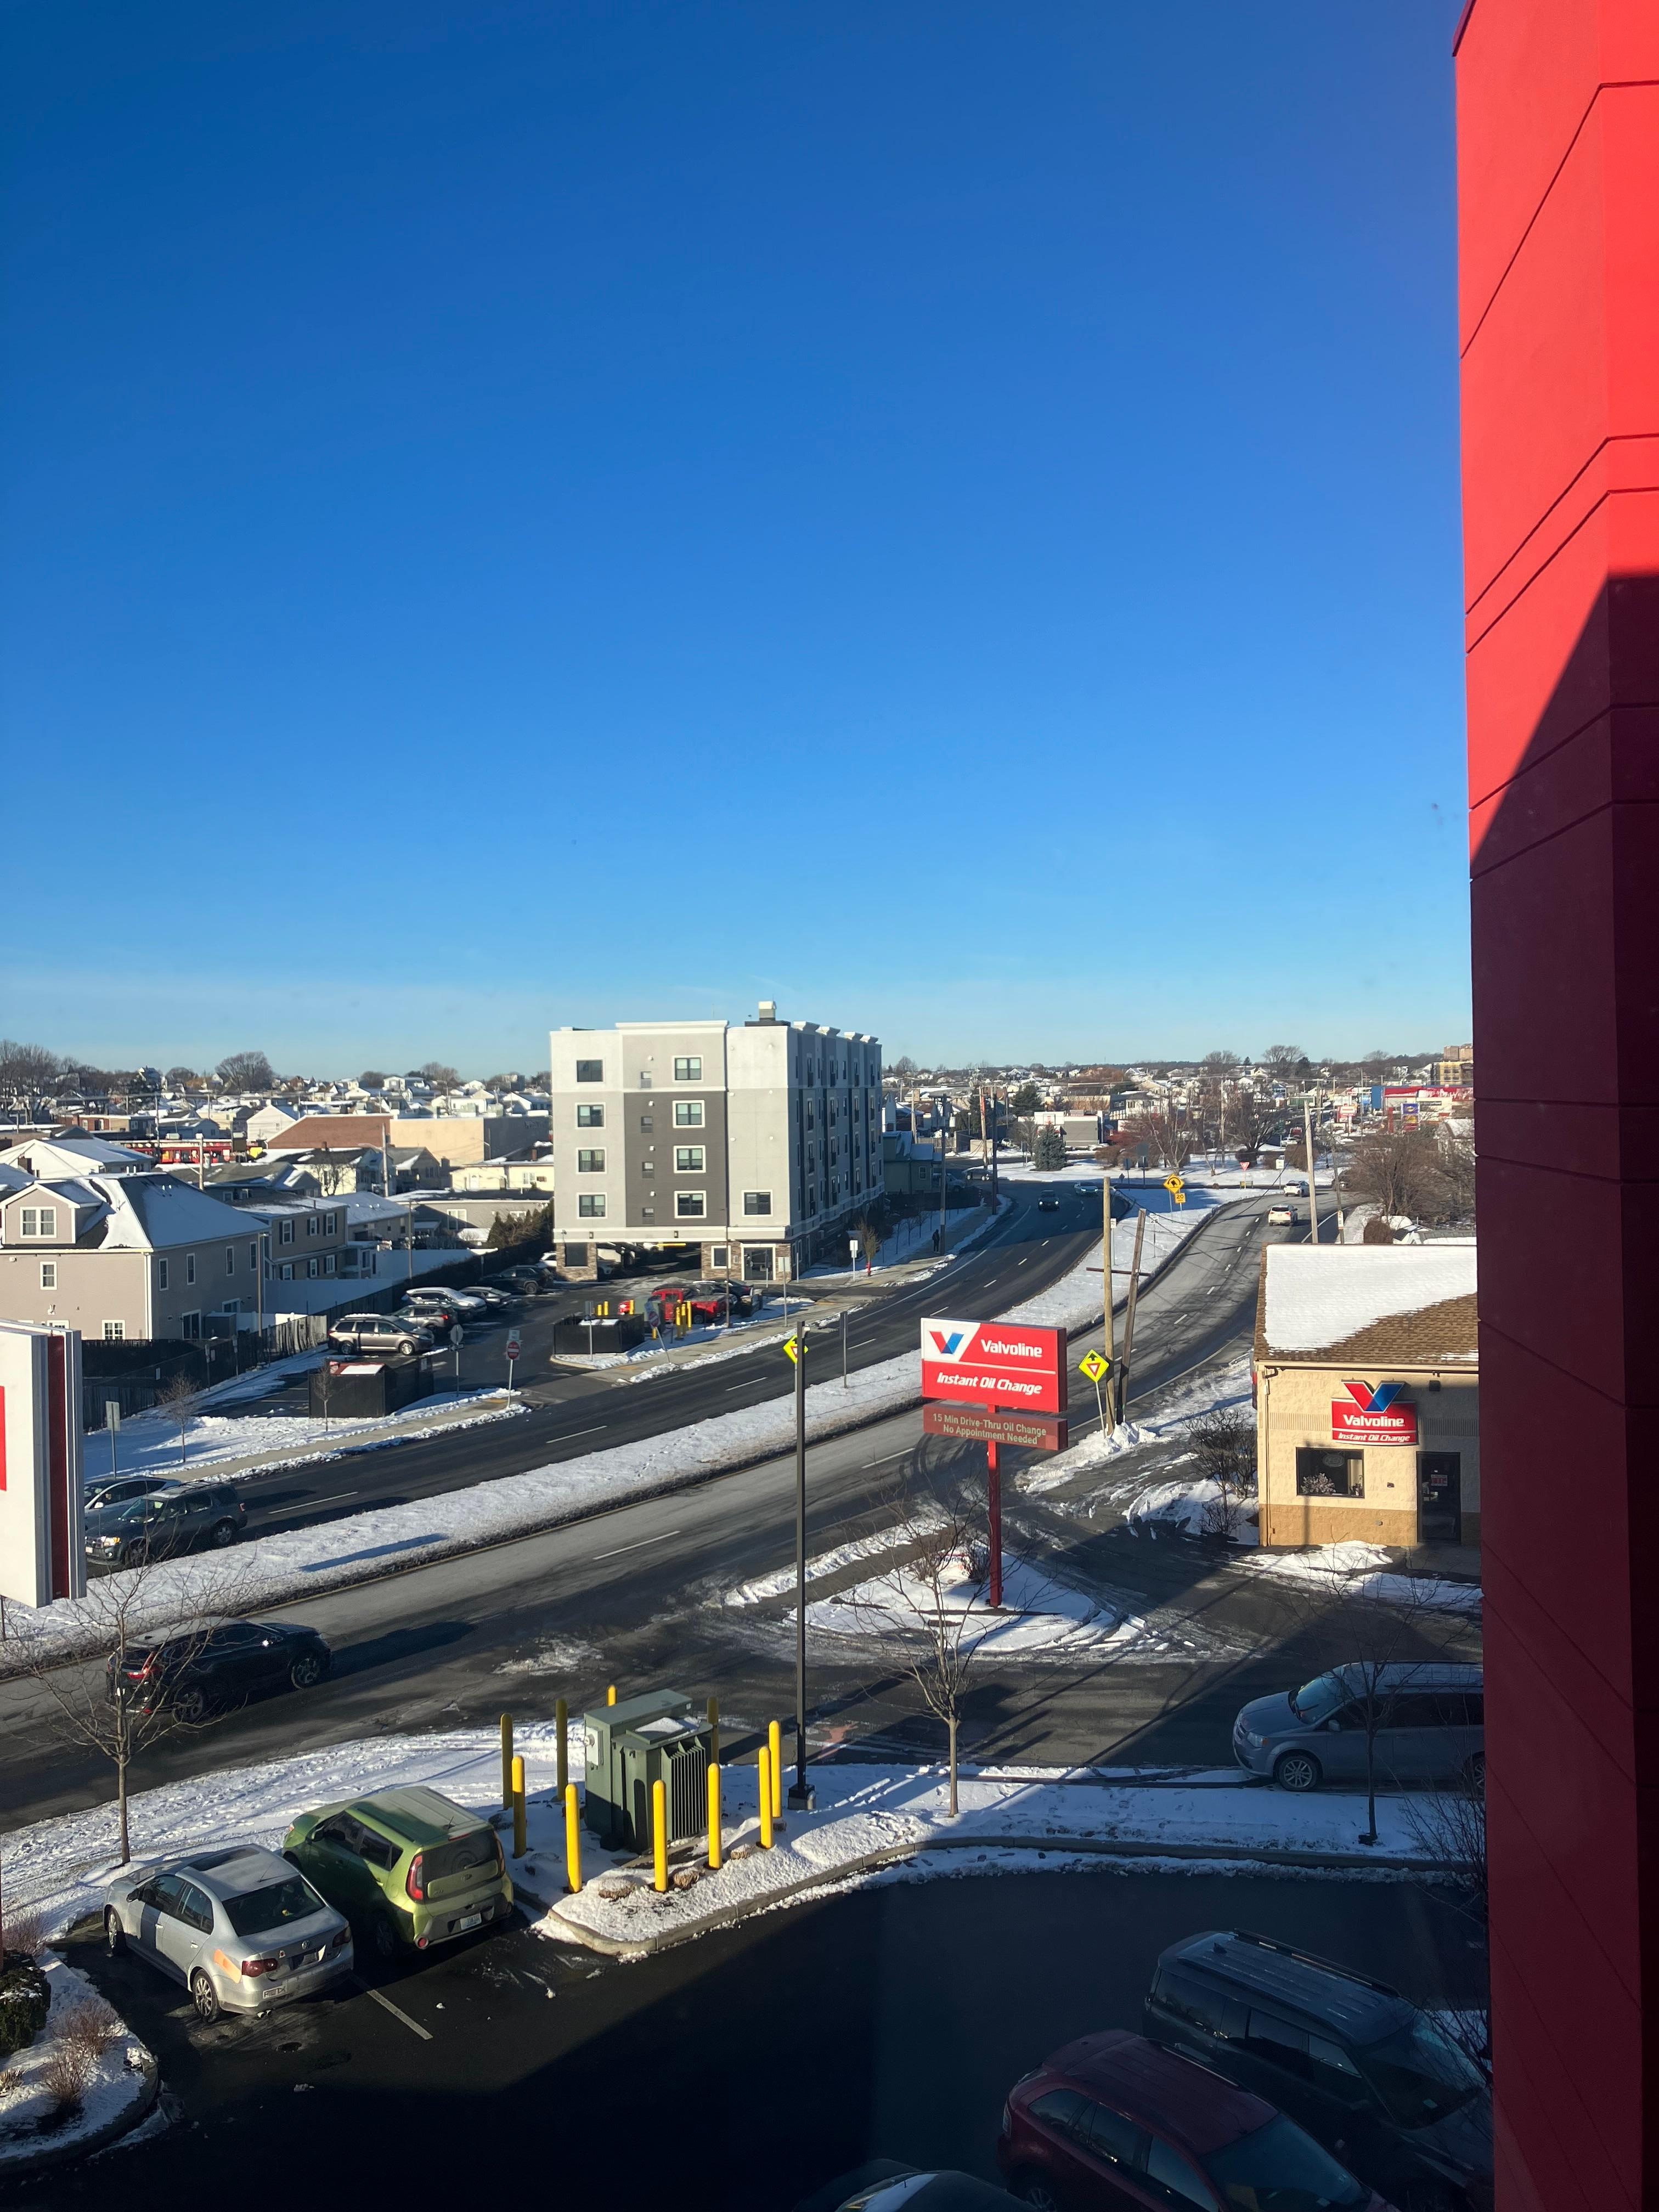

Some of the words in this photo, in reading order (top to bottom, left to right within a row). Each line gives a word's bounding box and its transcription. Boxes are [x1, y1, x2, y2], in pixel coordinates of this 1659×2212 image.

[981, 1339, 1042, 1357] Valvoline
[937, 1372, 979, 1387] Instant
[980, 1376, 996, 1389] Oil
[997, 1379, 1042, 1395] Change
[933, 1413, 943, 1422] 15
[944, 1414, 958, 1424] Min
[960, 1417, 1001, 1430] Drive-Thru
[1003, 1422, 1014, 1431] Oil
[1016, 1424, 1046, 1437] Change
[1343, 1414, 1404, 1426] Valvoline
[943, 1424, 954, 1433] No
[956, 1425, 1005, 1440] Appointment
[1007, 1433, 1037, 1444] Needed
[1338, 1433, 1367, 1441] Instant
